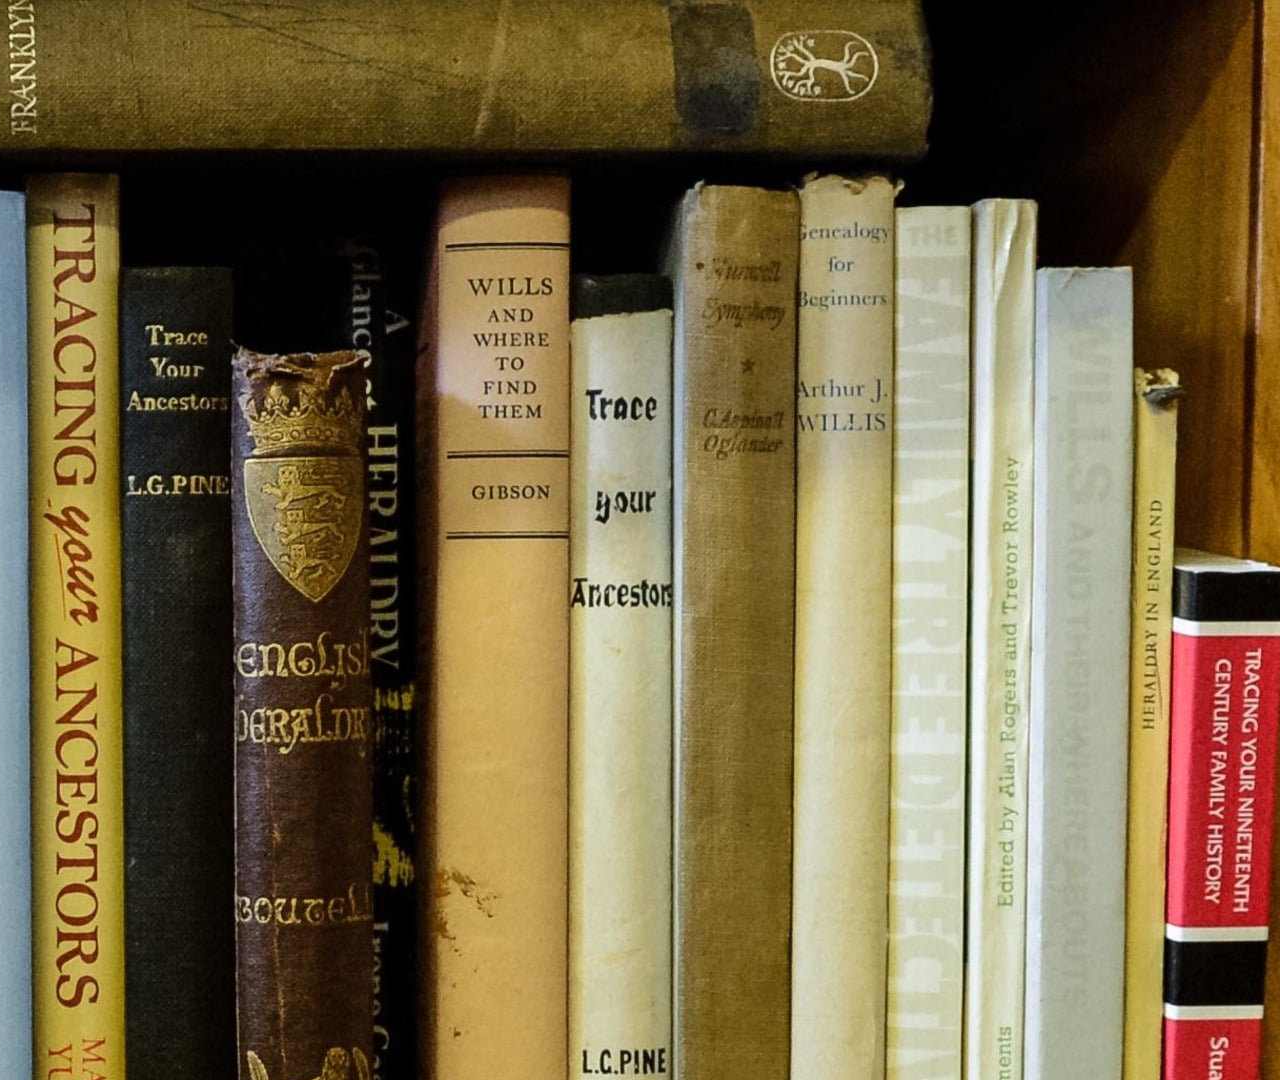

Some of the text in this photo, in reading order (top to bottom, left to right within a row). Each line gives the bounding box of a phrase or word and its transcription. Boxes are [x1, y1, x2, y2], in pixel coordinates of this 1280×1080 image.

[828, 256, 856, 273] for
[468, 277, 554, 297] WILLS
[487, 308, 535, 323] AND
[144, 325, 209, 347] Trace
[473, 332, 550, 348] WHERE
[150, 358, 205, 378] Your
[495, 358, 525, 372] TO
[483, 382, 538, 395] FIND
[796, 378, 866, 398] Arthur
[127, 390, 228, 412] Ancestors
[585, 388, 658, 422] Trace
[478, 404, 543, 420] THEM
[800, 412, 888, 433] WILLIS
[471, 484, 551, 500] GIBSON
[595, 487, 657, 524] your
[52, 203, 101, 1009] TRACING ANCESTORS
[1142, 499, 1163, 730] HERALDRY IN ENGLAND
[997, 456, 1021, 907] Edited by Alan Rogers and Trevor Rowley
[1204, 658, 1232, 903] CENTURY FAMILY HISTORY
[1232, 647, 1262, 913] TRACING YOUR NINETEENTH
